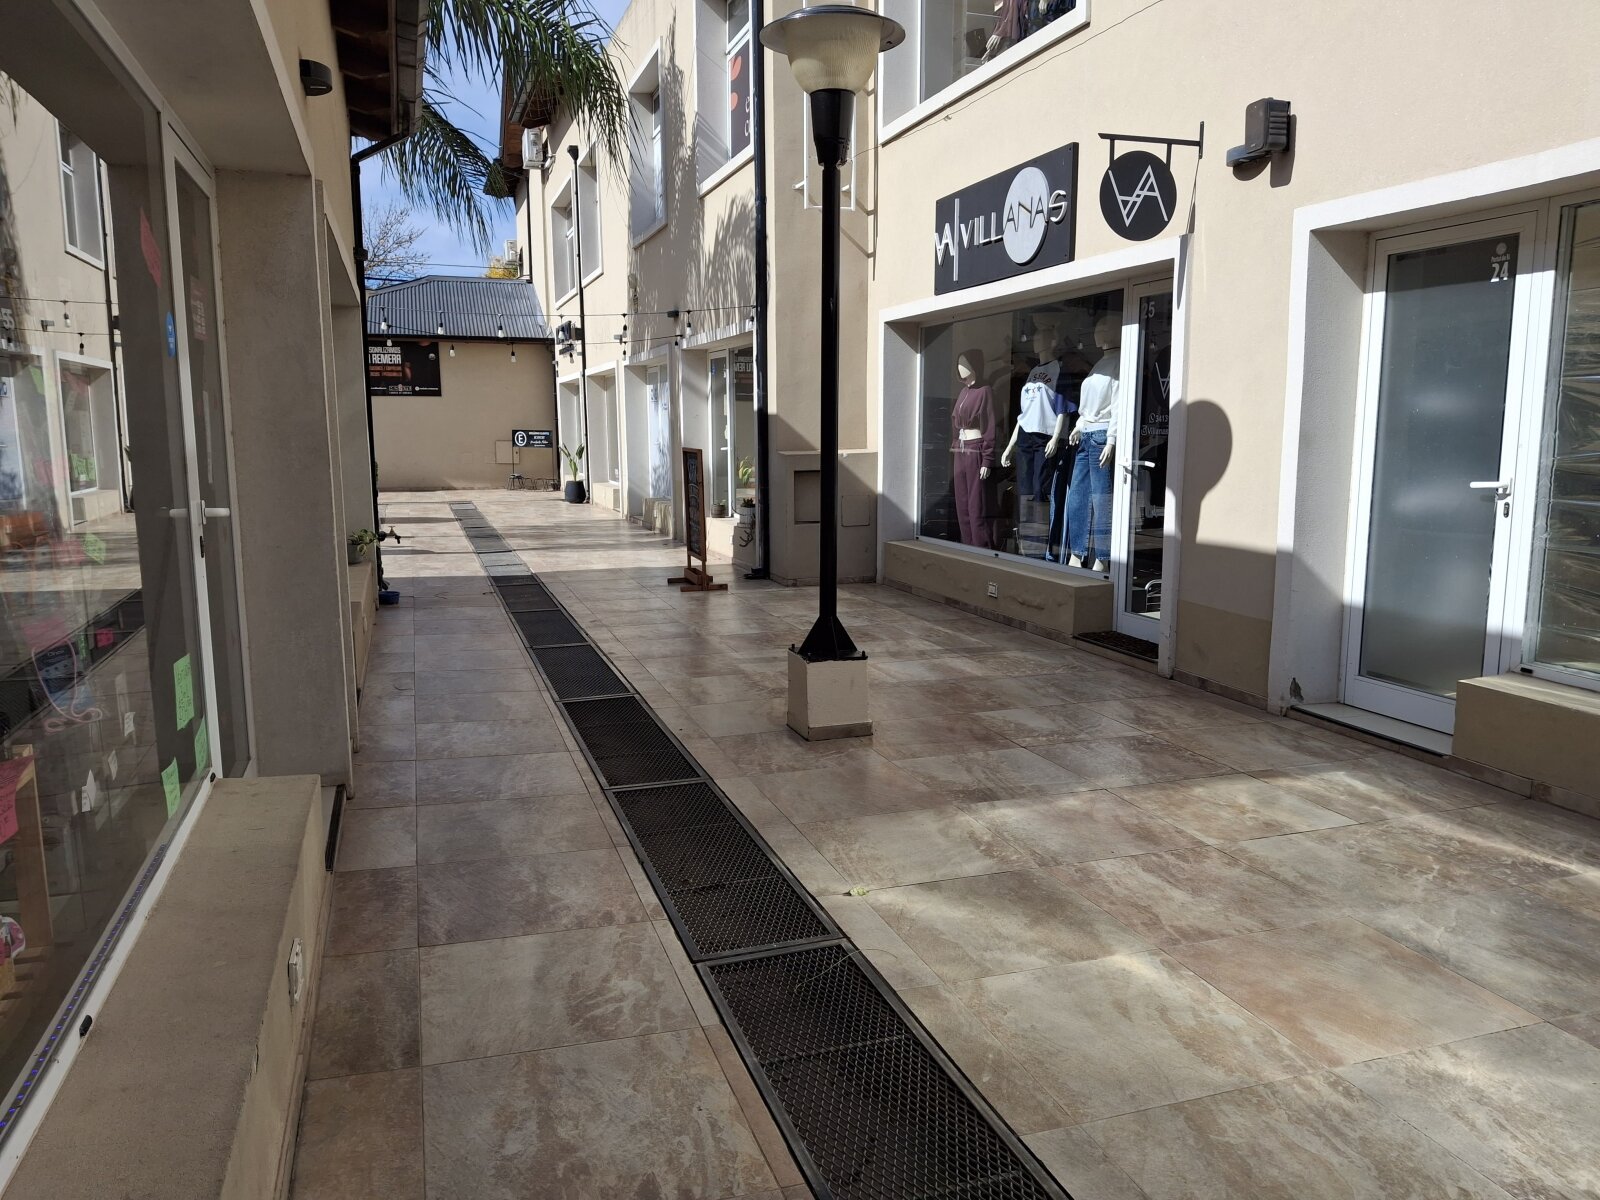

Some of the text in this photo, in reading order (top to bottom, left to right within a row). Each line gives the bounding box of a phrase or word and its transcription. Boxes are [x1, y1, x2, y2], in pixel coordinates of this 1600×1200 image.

[1108, 165, 1168, 227] VA
[960, 189, 1068, 249] VILLANAS
[1490, 261, 1509, 283] 24
[1141, 300, 1156, 319] 25
[371, 353, 402, 364] REMERA
[518, 434, 524, 444] E
